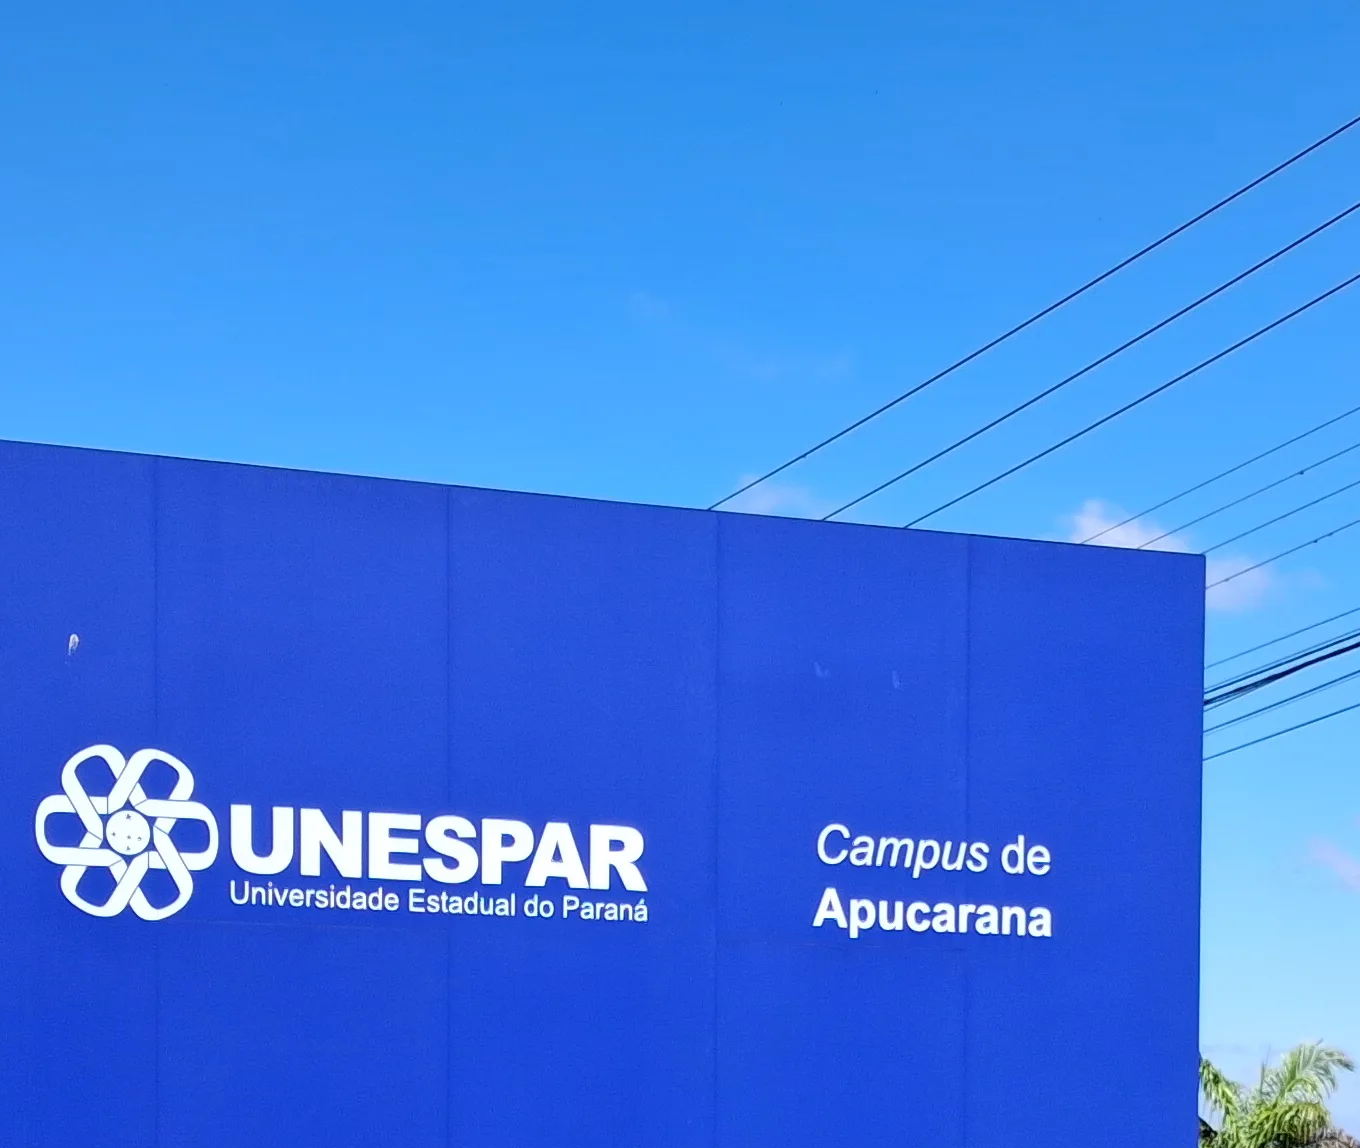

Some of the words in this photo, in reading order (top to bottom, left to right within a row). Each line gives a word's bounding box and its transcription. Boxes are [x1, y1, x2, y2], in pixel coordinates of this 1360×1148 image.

[230, 803, 648, 892] UNESPAR
[817, 823, 990, 878] Campus
[1001, 834, 1051, 876] de
[230, 879, 400, 912] Universidade
[408, 888, 517, 918] Estadual
[523, 894, 555, 919] do
[562, 894, 648, 923] Paraná
[812, 887, 1052, 938] Apucarana
